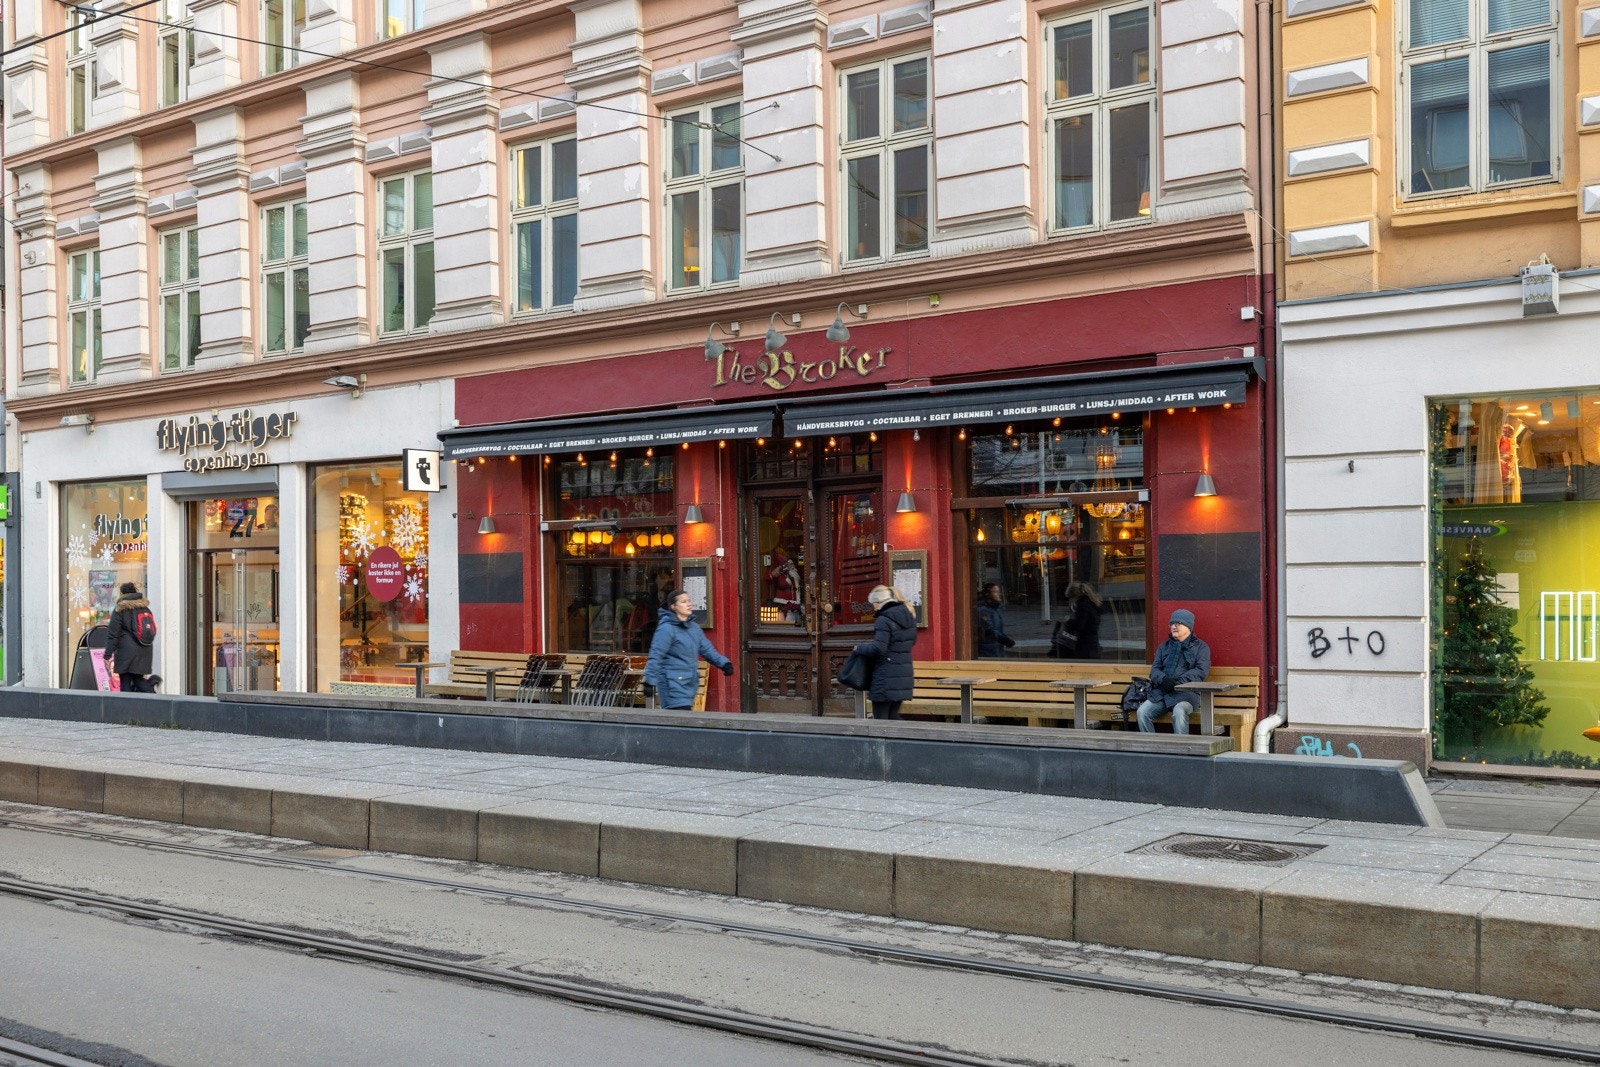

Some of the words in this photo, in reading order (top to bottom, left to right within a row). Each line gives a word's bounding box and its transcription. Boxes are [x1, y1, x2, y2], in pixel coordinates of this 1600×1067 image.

[709, 345, 757, 388] The
[797, 419, 865, 431] HÅNDVERKSBRYGG
[873, 415, 921, 426] COCTAILBAR
[930, 413, 950, 422] EGET
[953, 410, 994, 420] BRENNERI
[1003, 403, 1077, 416] BROKER-BURGER
[1086, 396, 1154, 409] LUNSJ/MIDDAG
[1164, 392, 1194, 402] AFTER
[1198, 390, 1227, 399] WORK
[156, 415, 227, 456] flying
[230, 409, 297, 449] tiger
[507, 443, 543, 451] COCTAILBAR
[549, 440, 565, 448] EGET
[566, 439, 596, 447] BRENNERI
[601, 434, 654, 444] BROKER-BURGER
[660, 430, 707, 440] LUNSJ/MIDDAG
[713, 427, 735, 435] AFTER
[184, 452, 269, 474] copenhagen
[416, 457, 431, 485] t
[94, 512, 142, 541] flying
[229, 508, 258, 538] 27
[375, 576, 394, 584] formue
